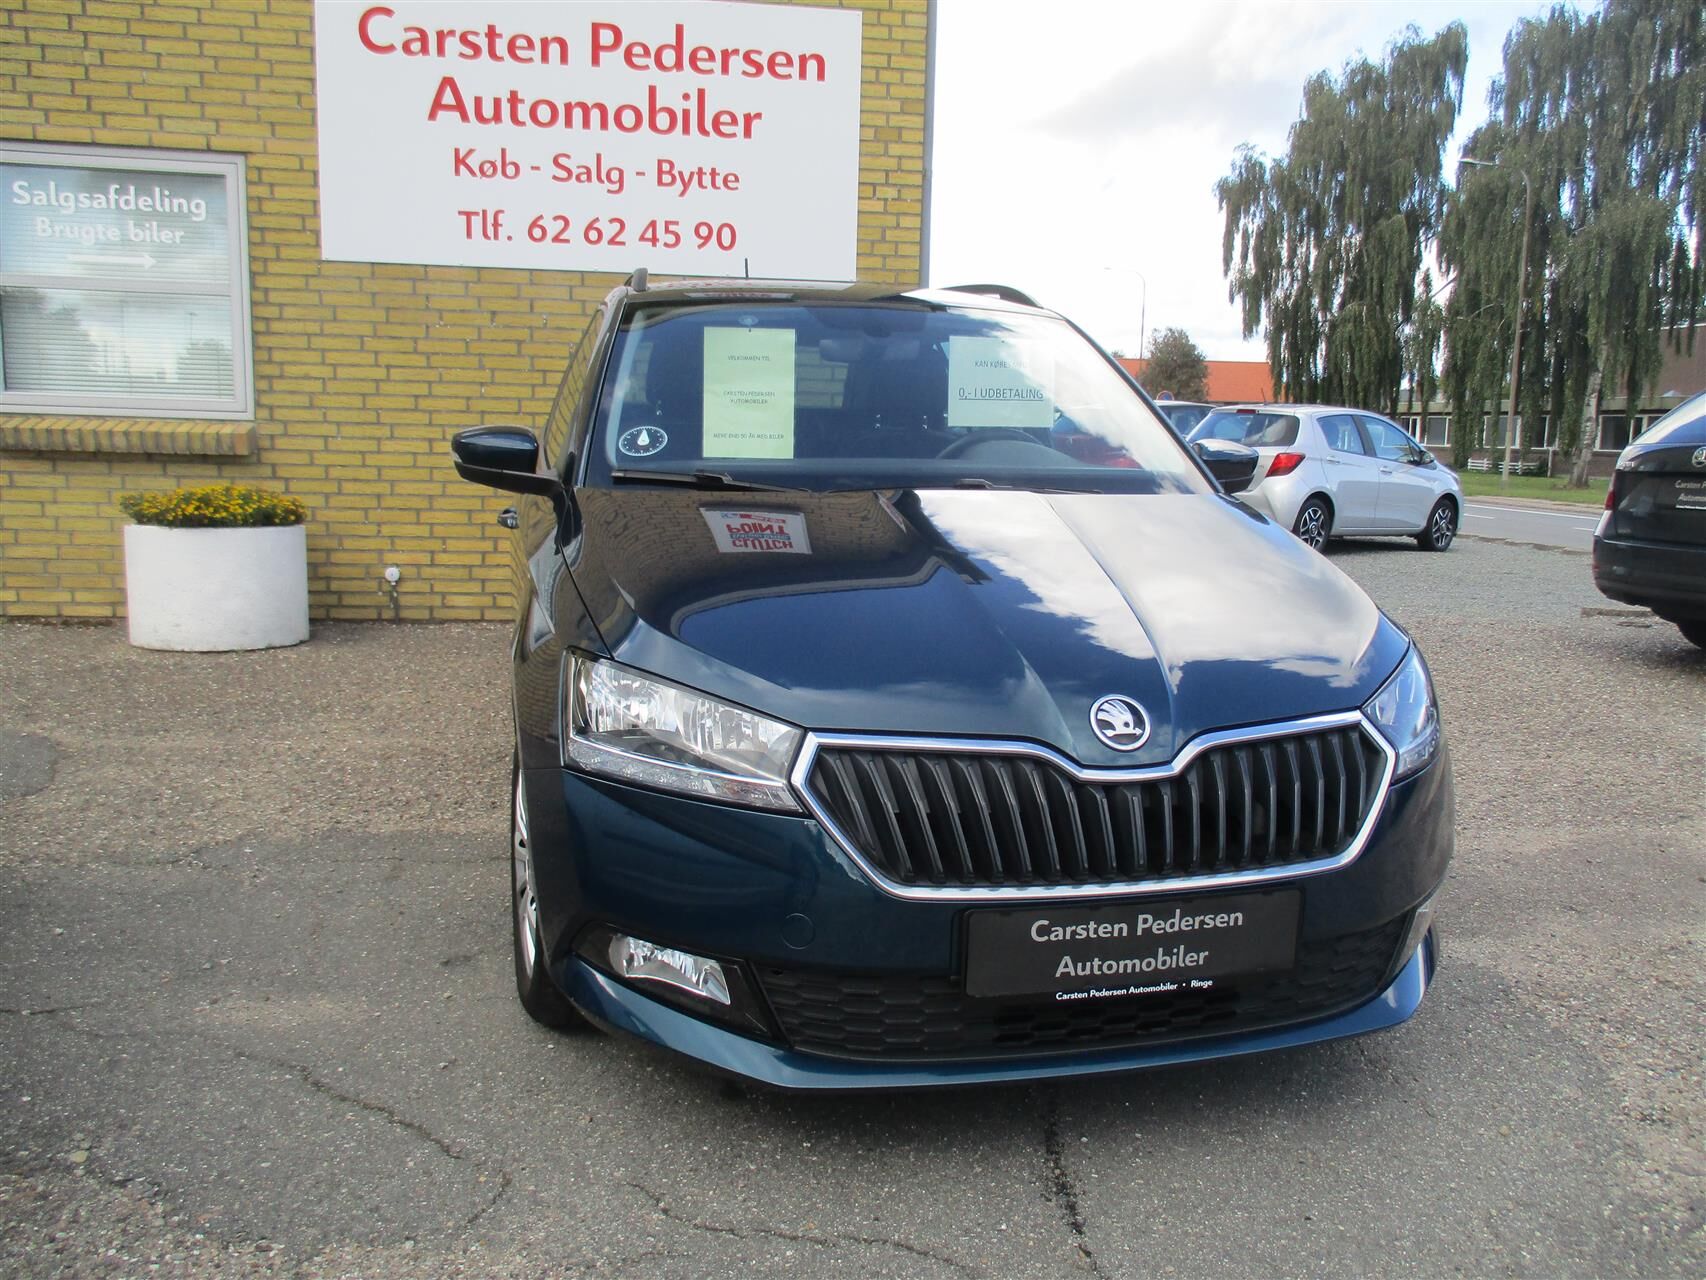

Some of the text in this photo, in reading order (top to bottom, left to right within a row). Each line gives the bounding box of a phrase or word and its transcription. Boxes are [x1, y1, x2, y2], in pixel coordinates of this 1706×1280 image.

[357, 6, 827, 82] Carsten Pedersen
[427, 76, 763, 140] Automobiler
[453, 147, 521, 181] Køb
[551, 153, 625, 194] Salg
[656, 159, 741, 198] Bytte
[12, 180, 207, 222] Salgsafdeling
[35, 216, 185, 245] Brugte biler
[458, 209, 737, 252] Tlf. 62 62 45 90
[974, 360, 989, 368] KAN
[980, 388, 1044, 399] UDBETALING
[1030, 909, 1243, 942] Carsten Pedersen
[1055, 945, 1209, 978] Automobiler
[1055, 979, 1213, 1001] Carsten Pedersen Automobiler Ringe
